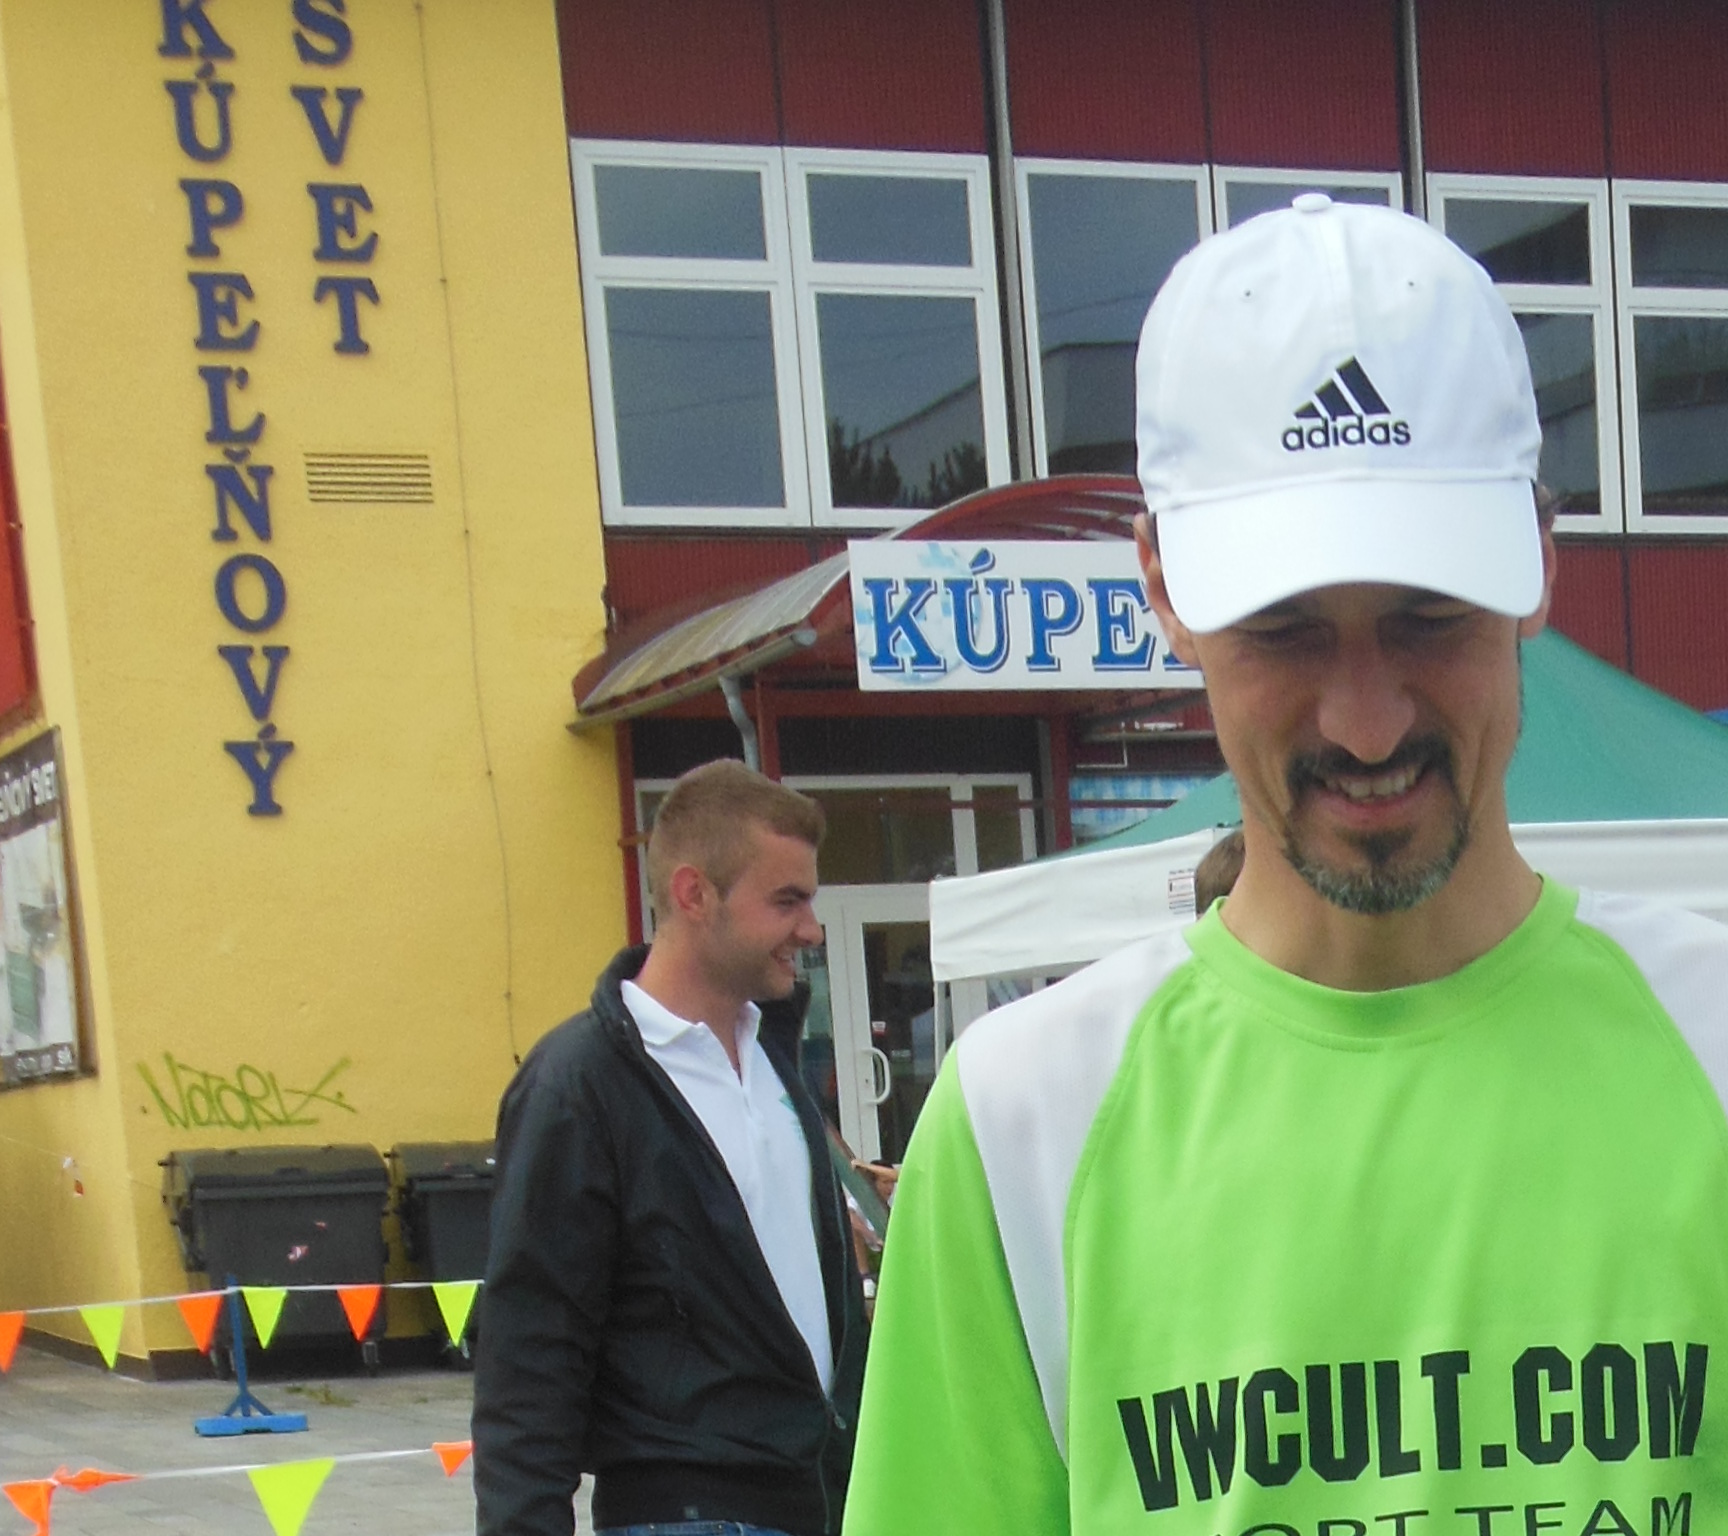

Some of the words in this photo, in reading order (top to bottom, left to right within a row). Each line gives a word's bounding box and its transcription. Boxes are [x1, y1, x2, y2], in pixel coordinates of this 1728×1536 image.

[290, 0, 381, 355] SVET
[1281, 415, 1412, 452] adidas
[861, 547, 1200, 675] KÚPE
[1116, 1340, 1709, 1512] VWCULT.COM
